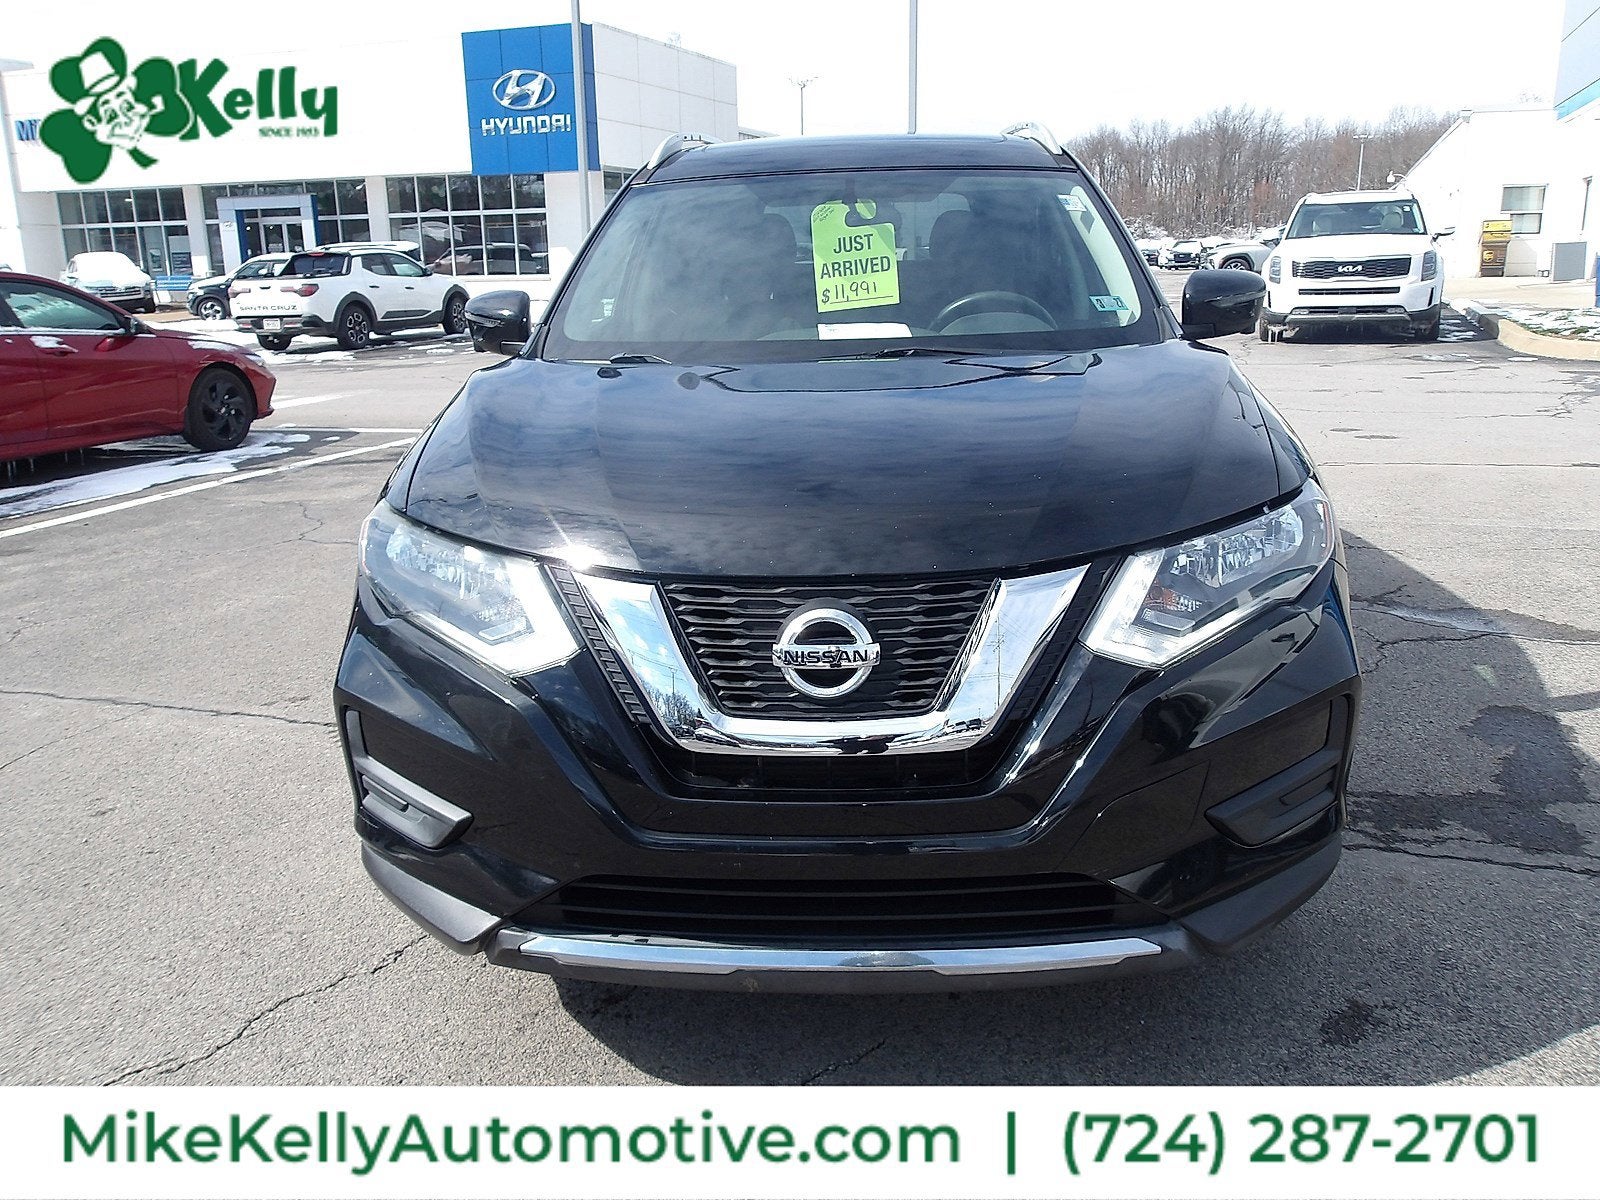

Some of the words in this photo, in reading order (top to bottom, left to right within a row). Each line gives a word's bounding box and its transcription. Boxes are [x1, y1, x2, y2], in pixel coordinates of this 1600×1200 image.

[480, 113, 572, 137] HYUNDAI
[833, 233, 874, 254] JUST
[820, 255, 891, 279] ARRIVED
[239, 304, 269, 312] SANTA
[270, 304, 298, 312] CRUZ
[783, 648, 868, 667] NISSAN
